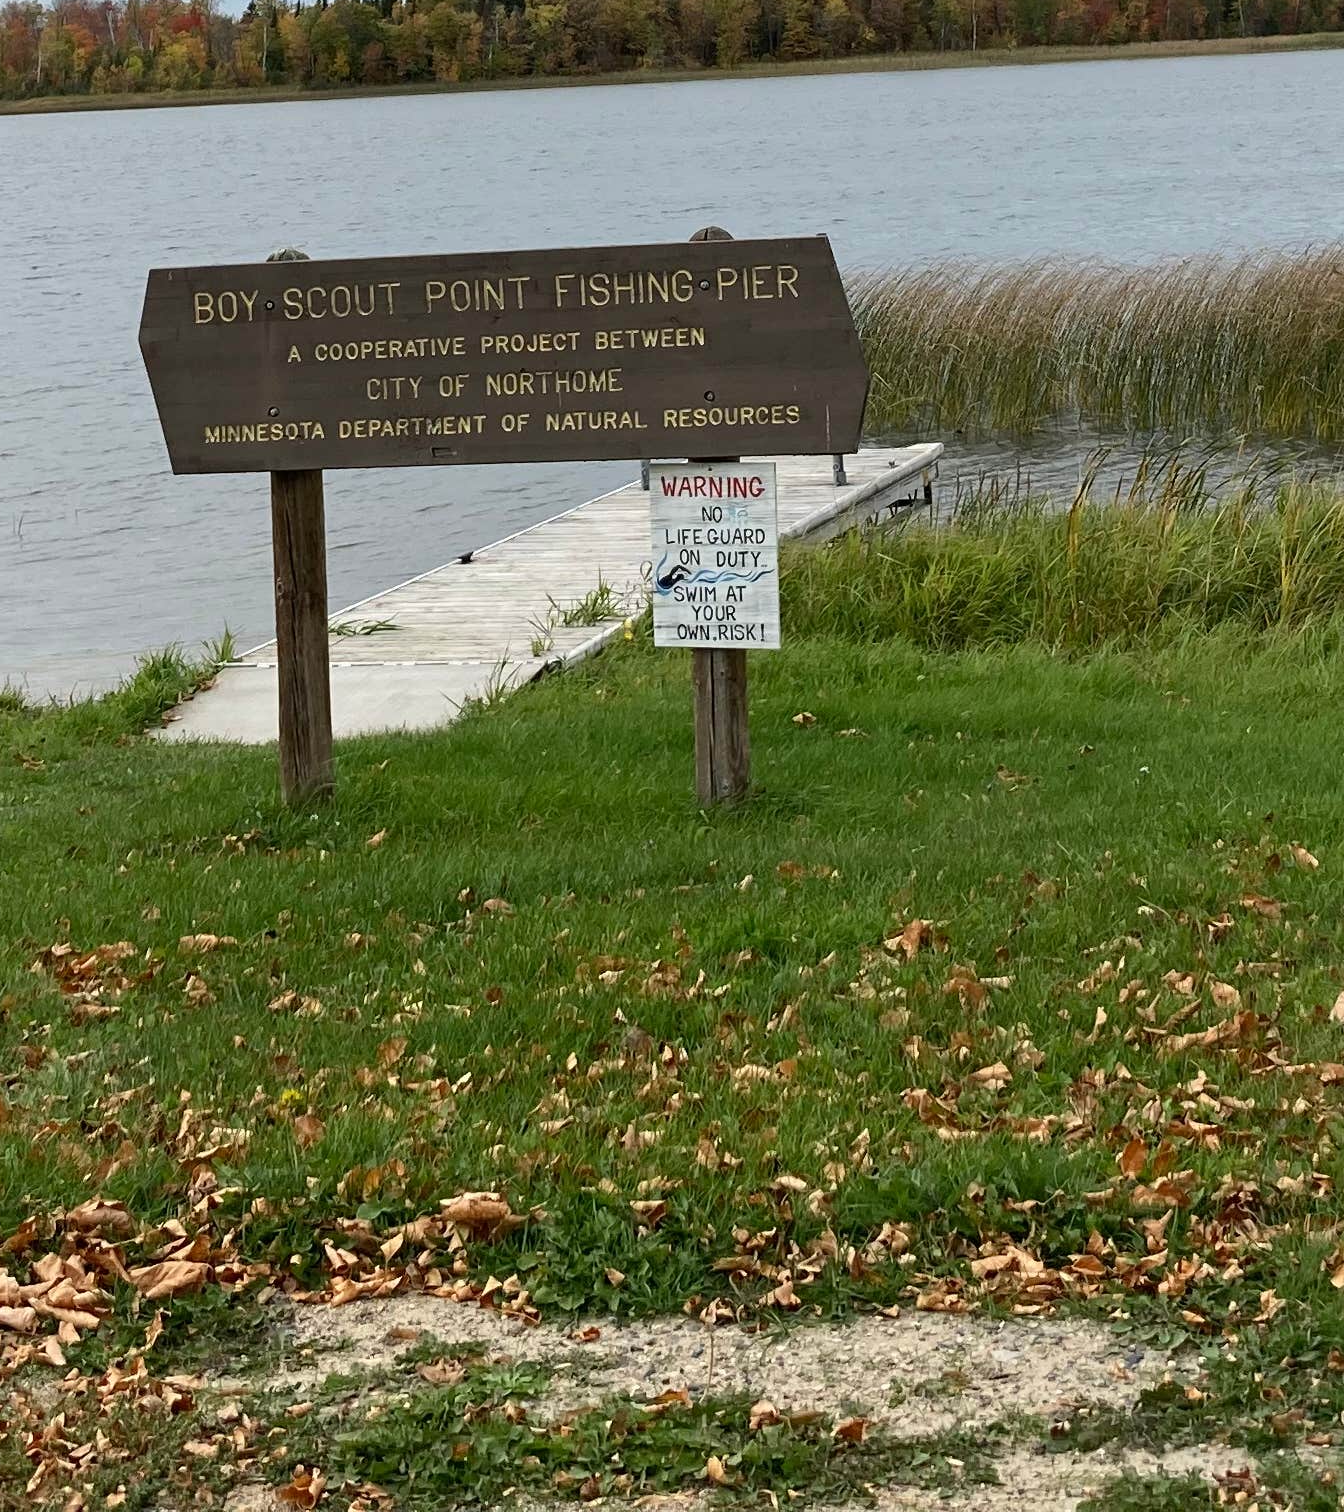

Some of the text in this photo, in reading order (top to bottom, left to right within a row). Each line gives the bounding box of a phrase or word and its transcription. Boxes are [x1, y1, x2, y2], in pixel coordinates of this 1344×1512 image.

[193, 265, 800, 324] BOY SCOUT POINT FISHING PIER
[287, 327, 706, 363] A COOPERATIVE PROJECT BETWEEN
[367, 368, 623, 401] CITY OF NORTHOME
[204, 405, 800, 445] MINNESOTA DEPARTMENT OF NATURAL RESOURCES
[660, 476, 765, 498] WARNING
[701, 506, 722, 522] NO
[679, 549, 700, 566] ON
[673, 585, 746, 603] SWIM AT
[691, 605, 736, 621] YOUR
[718, 623, 766, 642] RISK!
